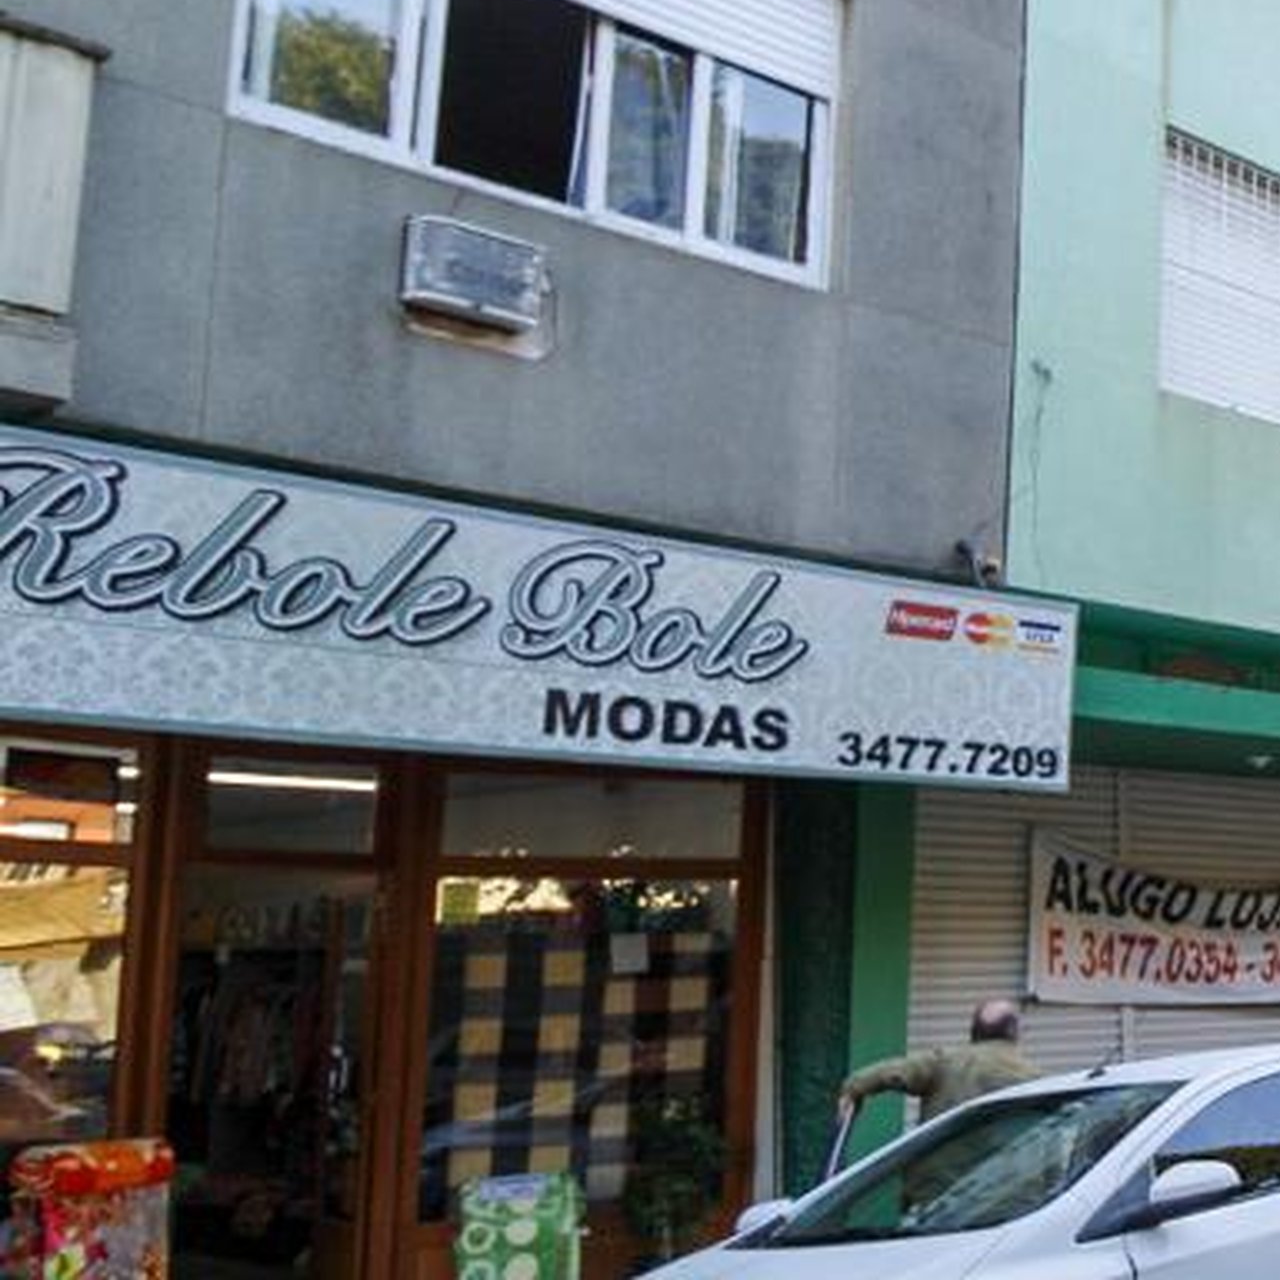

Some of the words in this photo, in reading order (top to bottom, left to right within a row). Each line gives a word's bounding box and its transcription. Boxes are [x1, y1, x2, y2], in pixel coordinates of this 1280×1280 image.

[0, 446, 491, 646] Rebole
[500, 539, 809, 683] Bole
[542, 688, 789, 752] MODAS
[837, 732, 1059, 778] 3477.7209
[1045, 856, 1197, 923] ALUGO
[1079, 929, 1239, 984] 3477.0354
